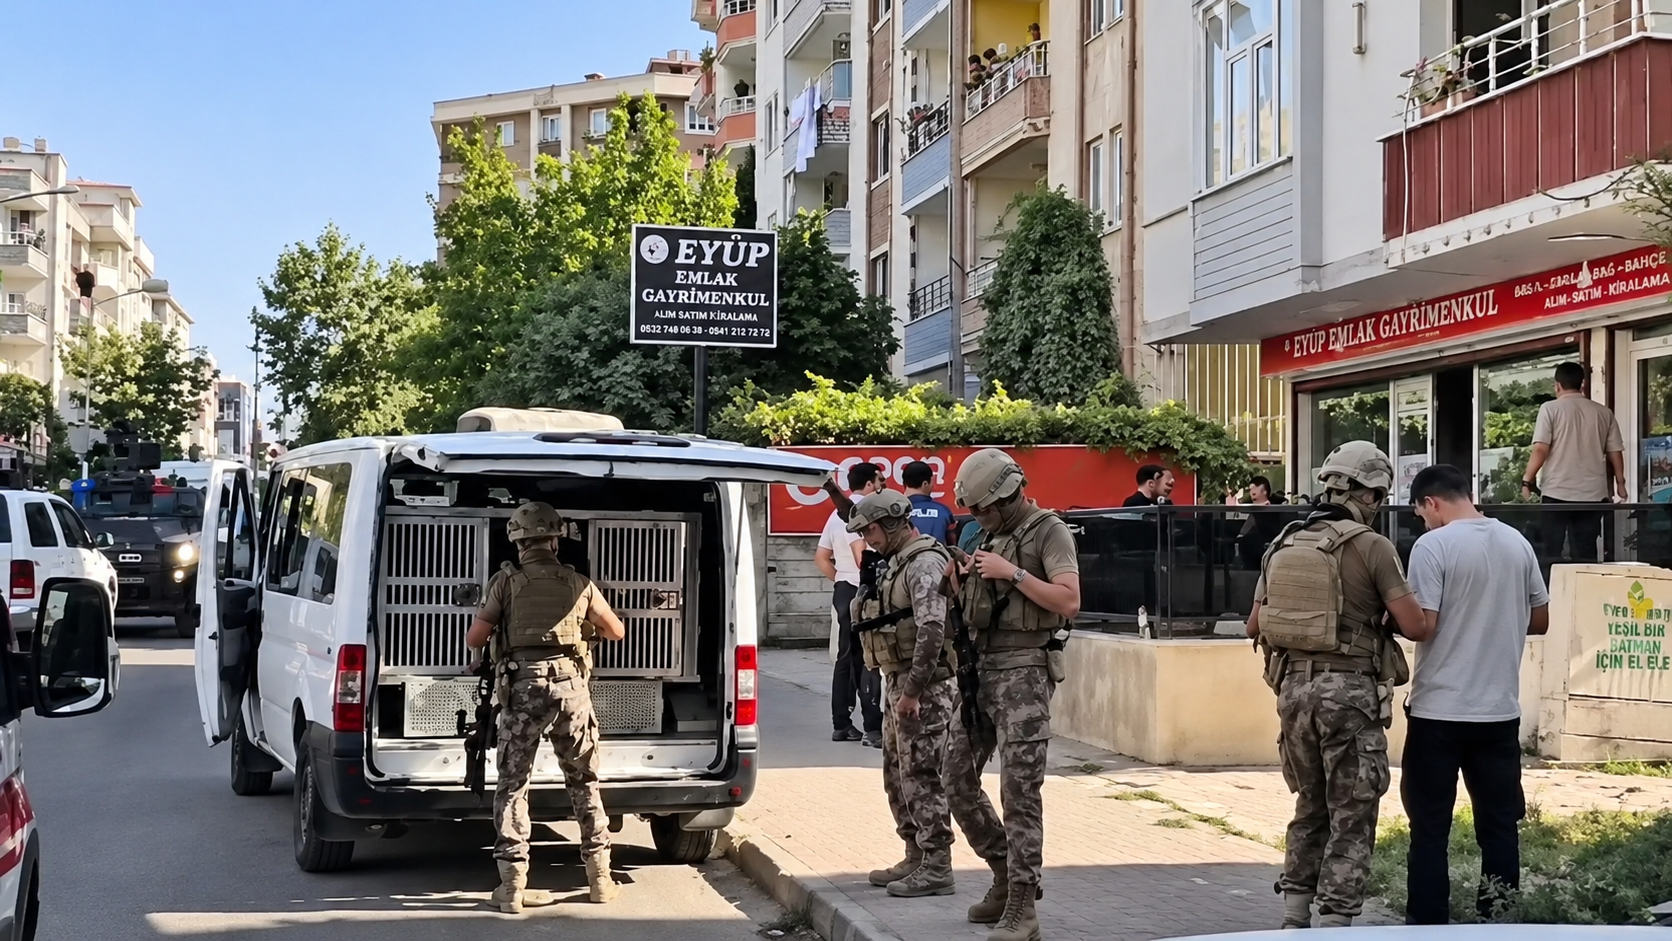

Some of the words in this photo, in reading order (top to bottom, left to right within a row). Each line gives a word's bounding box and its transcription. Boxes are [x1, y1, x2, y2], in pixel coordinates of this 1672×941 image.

[1625, 251, 1666, 272] BAHÇE
[675, 270, 738, 286] EMLAK
[642, 287, 770, 306] GAYRİMENKUL
[654, 310, 676, 319] ALIM
[678, 311, 707, 320] SATIM
[710, 310, 758, 322] KİRALAMA
[1327, 317, 1377, 351] EMLAK
[1379, 289, 1499, 339] GAYRİMENKUL
[640, 324, 661, 333] 0532
[663, 325, 678, 334] 748
[680, 325, 691, 334] 06
[709, 326, 729, 336] 0541
[731, 327, 746, 336] 212
[748, 328, 759, 337] 72
[760, 328, 770, 337] 72
[1608, 621, 1640, 637] YEŞİL
[1610, 638, 1661, 655] BATMAN
[1628, 654, 1643, 670] EL
[1647, 655, 1670, 670] ELE
